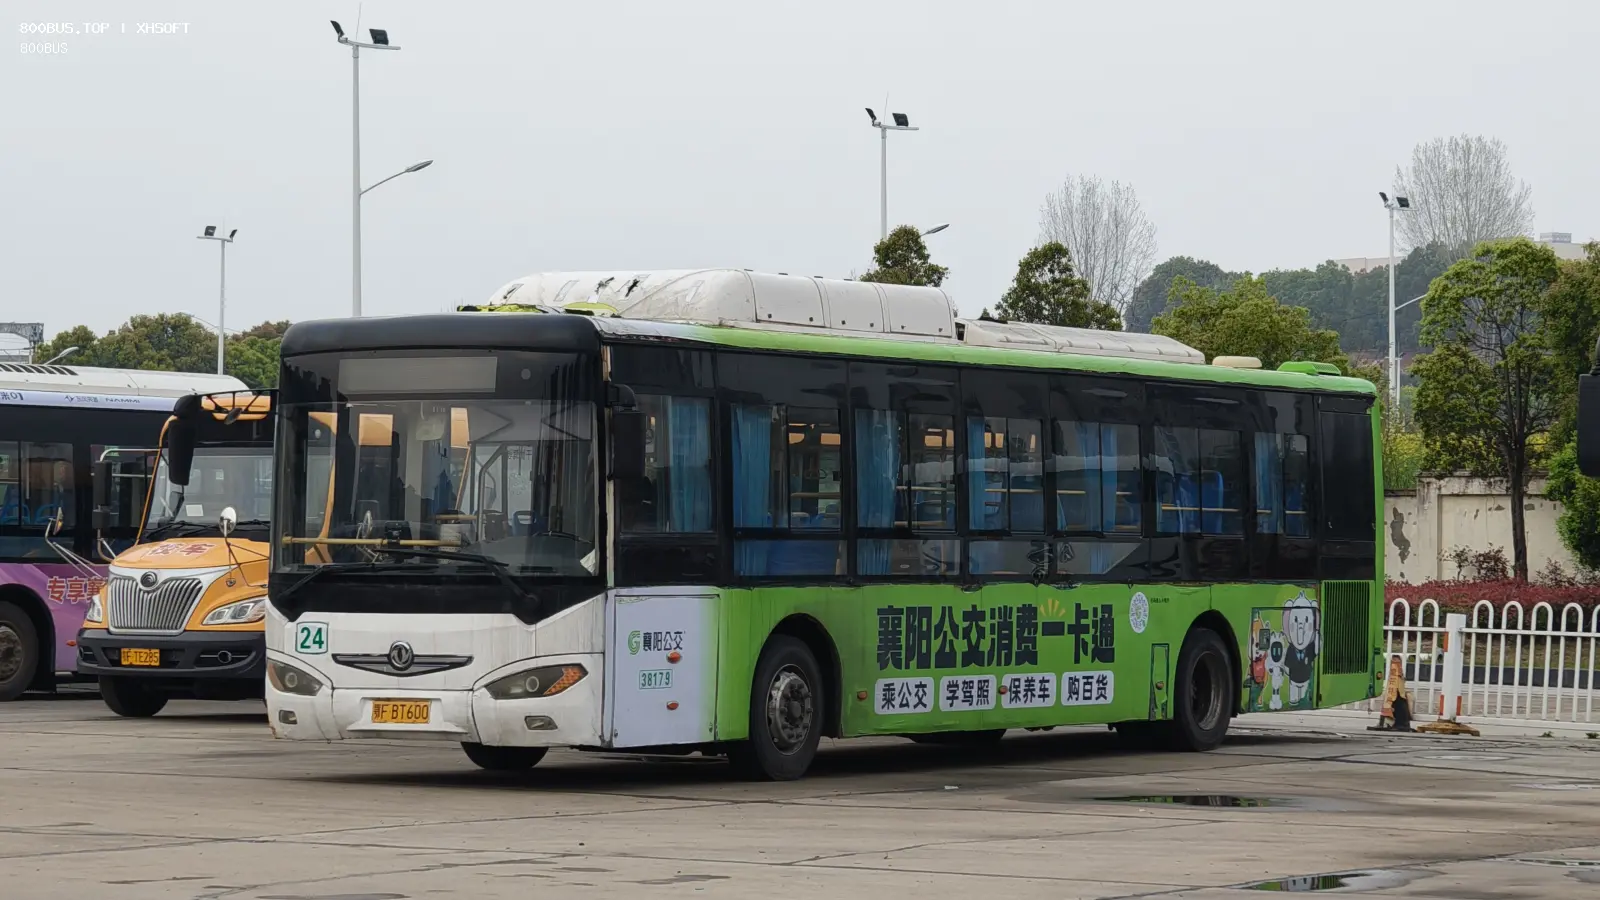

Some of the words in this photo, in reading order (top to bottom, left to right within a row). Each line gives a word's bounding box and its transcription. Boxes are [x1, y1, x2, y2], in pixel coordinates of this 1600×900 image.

[300, 626, 325, 650] 24
[643, 631, 683, 651] 襄阳公交
[876, 602, 1115, 671] 襄阳公交消费一卡通
[641, 671, 671, 687] 38179
[945, 678, 990, 708] 学驾照
[1008, 675, 1051, 704] 保养车
[1067, 673, 1108, 702] 购百货
[881, 681, 928, 710] 乘公交
